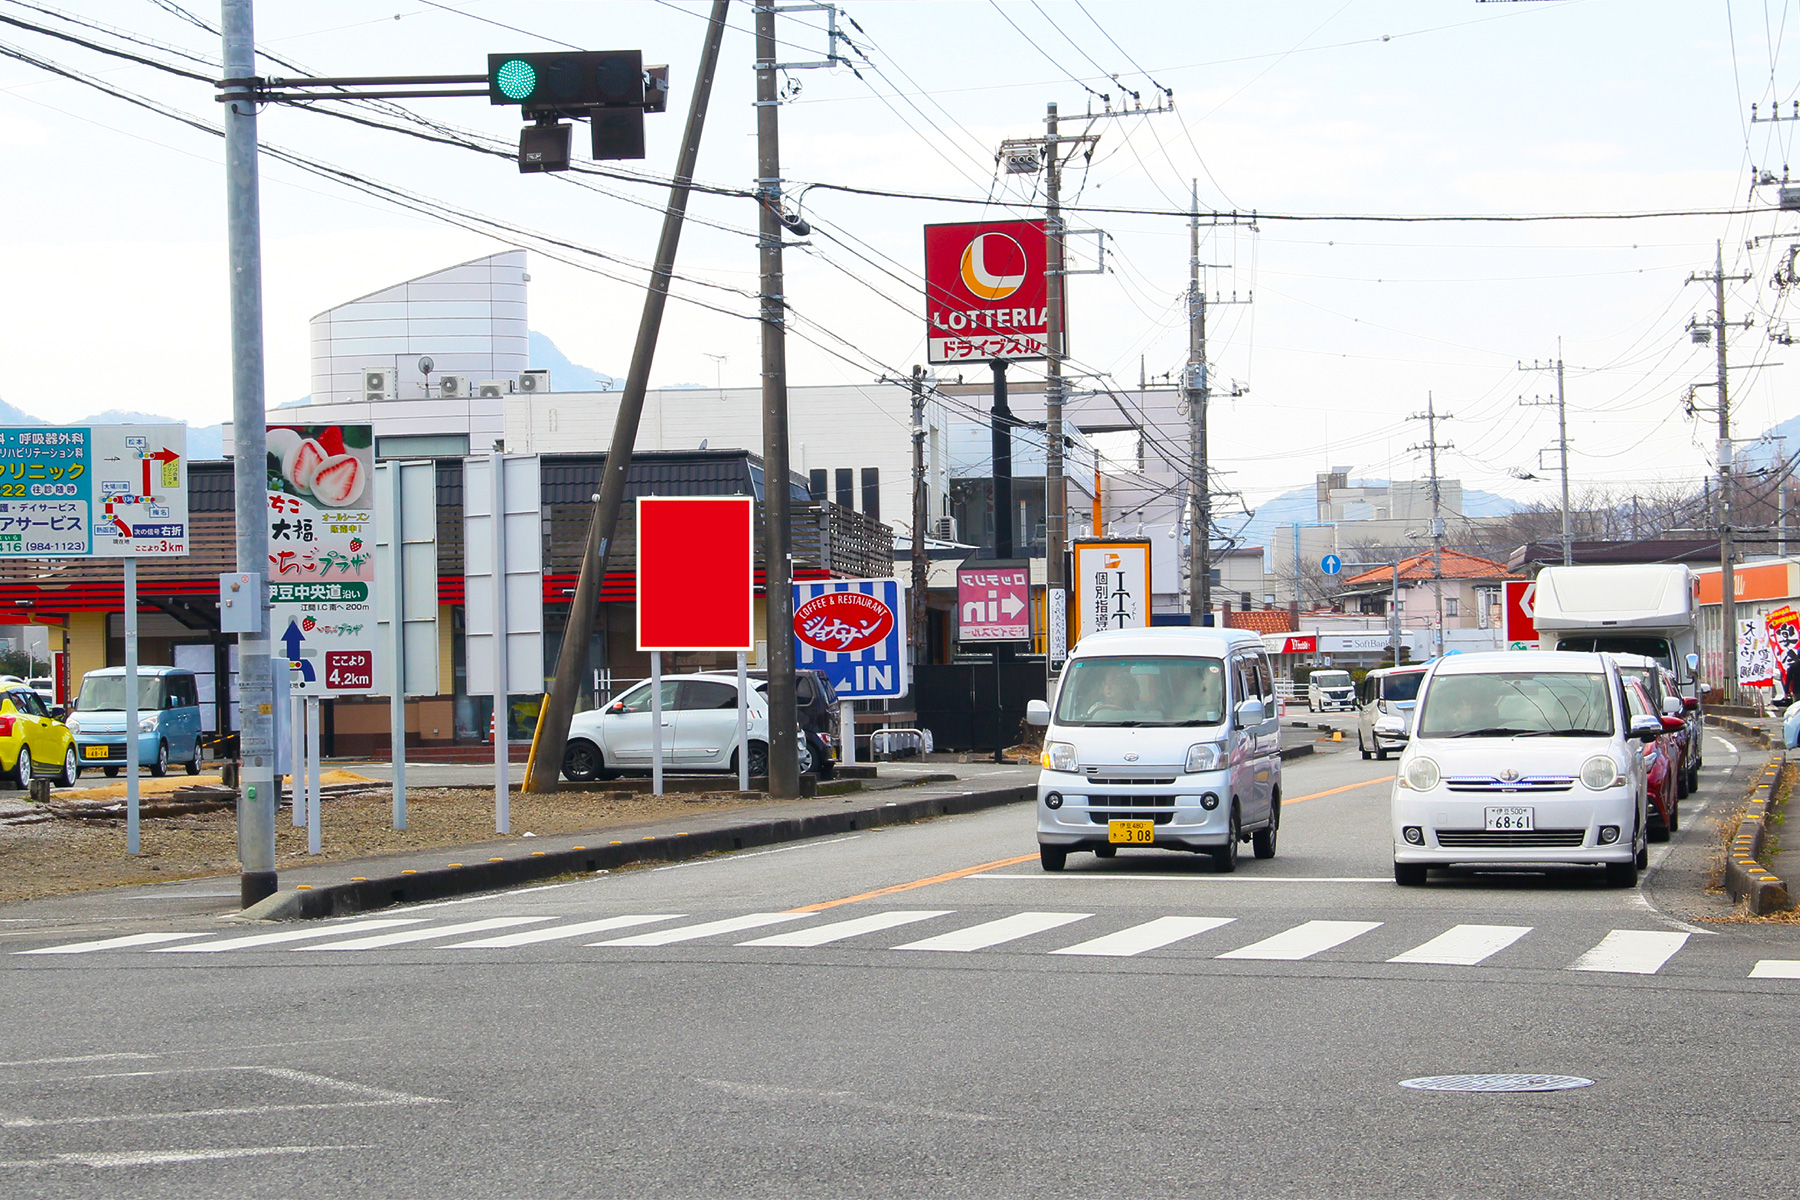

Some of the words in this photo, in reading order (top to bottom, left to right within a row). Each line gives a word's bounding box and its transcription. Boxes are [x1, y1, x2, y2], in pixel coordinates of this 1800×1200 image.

[943, 337, 1047, 358] ドライブスル
[0, 483, 26, 497] 22
[267, 495, 303, 514] ちご
[322, 513, 370, 521] オールシーズン
[26, 541, 85, 551] (984-1123)
[799, 598, 827, 619] COFFEE
[829, 596, 835, 605] &
[838, 595, 888, 617] RESTAURANT
[1095, 571, 1108, 632] 個別指導
[1355, 640, 1390, 648] SoftBank
[332, 655, 365, 666] ここより
[329, 668, 369, 685] 4.2km
[855, 665, 892, 690] IN
[1496, 816, 1530, 828] 68-61
